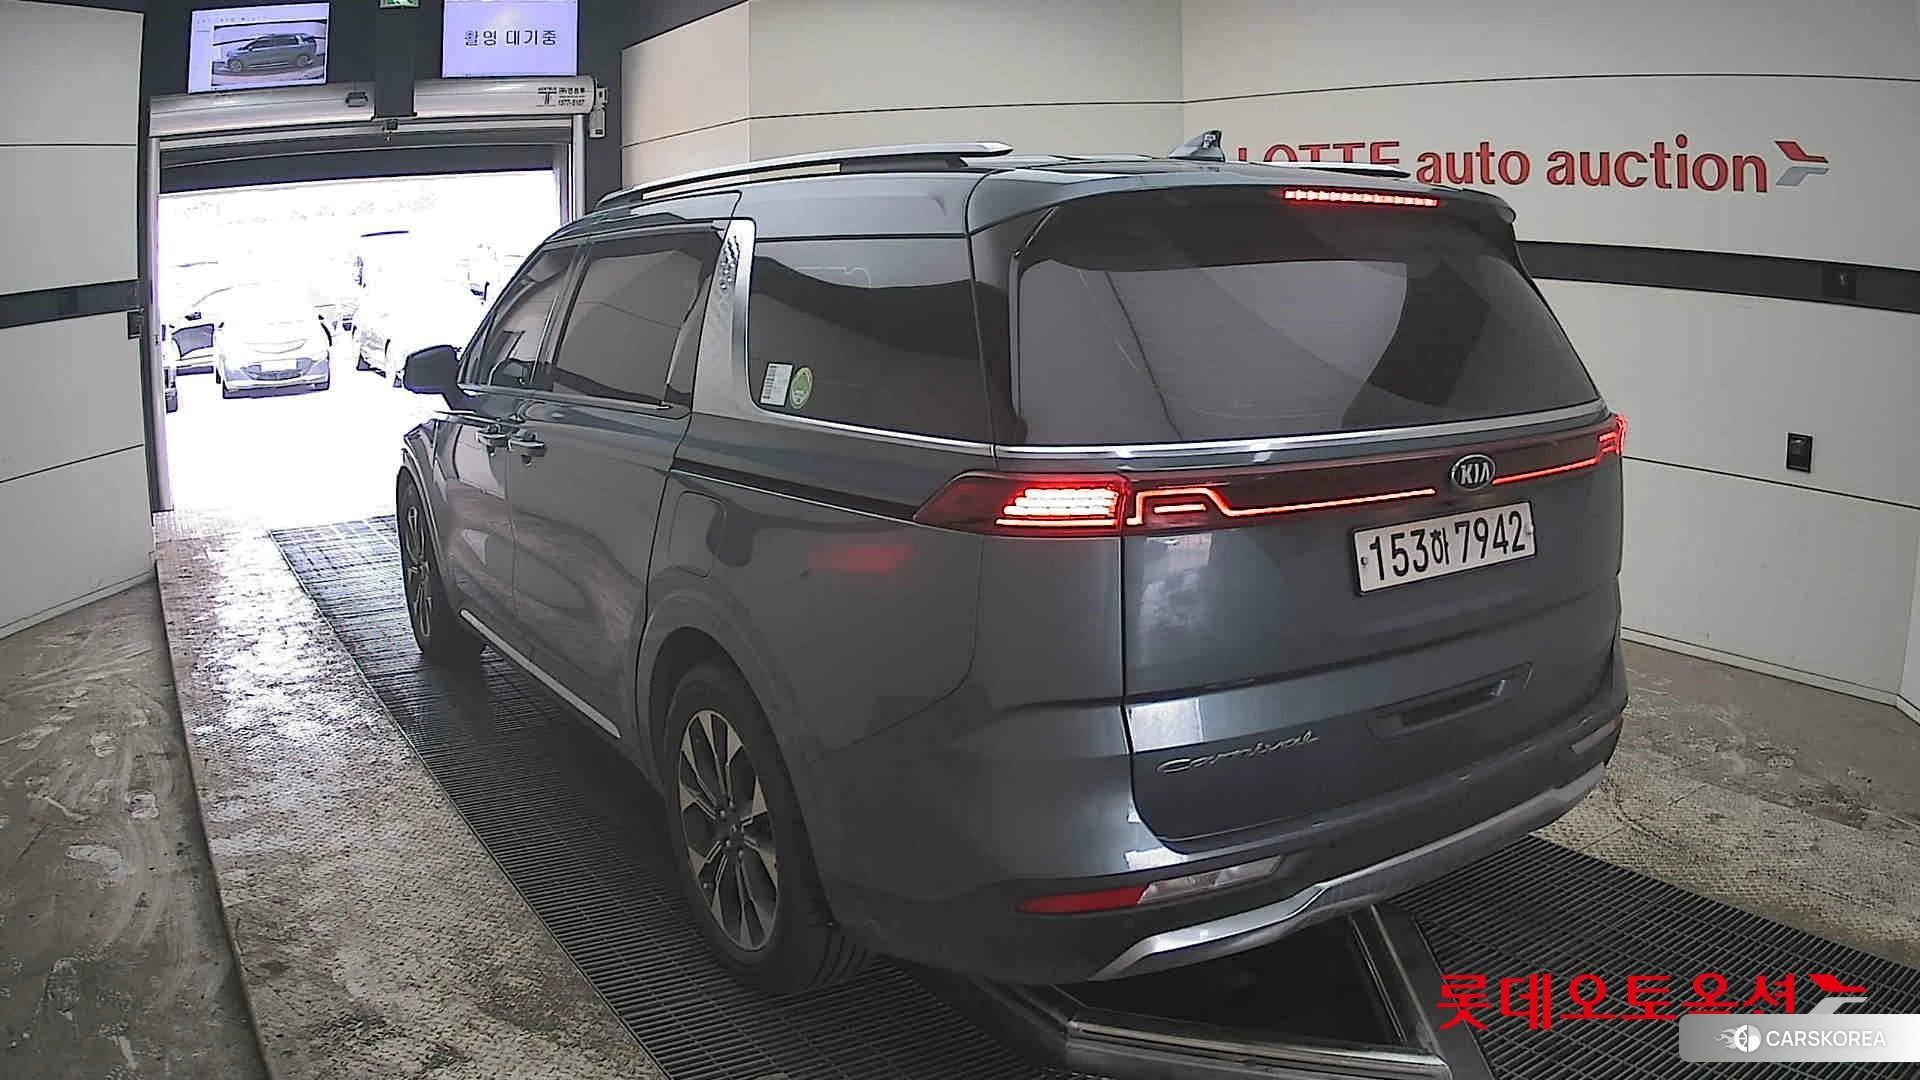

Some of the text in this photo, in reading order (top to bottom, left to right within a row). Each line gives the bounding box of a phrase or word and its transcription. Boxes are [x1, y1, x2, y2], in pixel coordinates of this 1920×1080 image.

[506, 30, 556, 46] 대기중
[1416, 141, 1531, 185] auto
[1546, 134, 1768, 192] auction
[1460, 461, 1490, 485] KIA
[1156, 729, 1319, 773] Carnival
